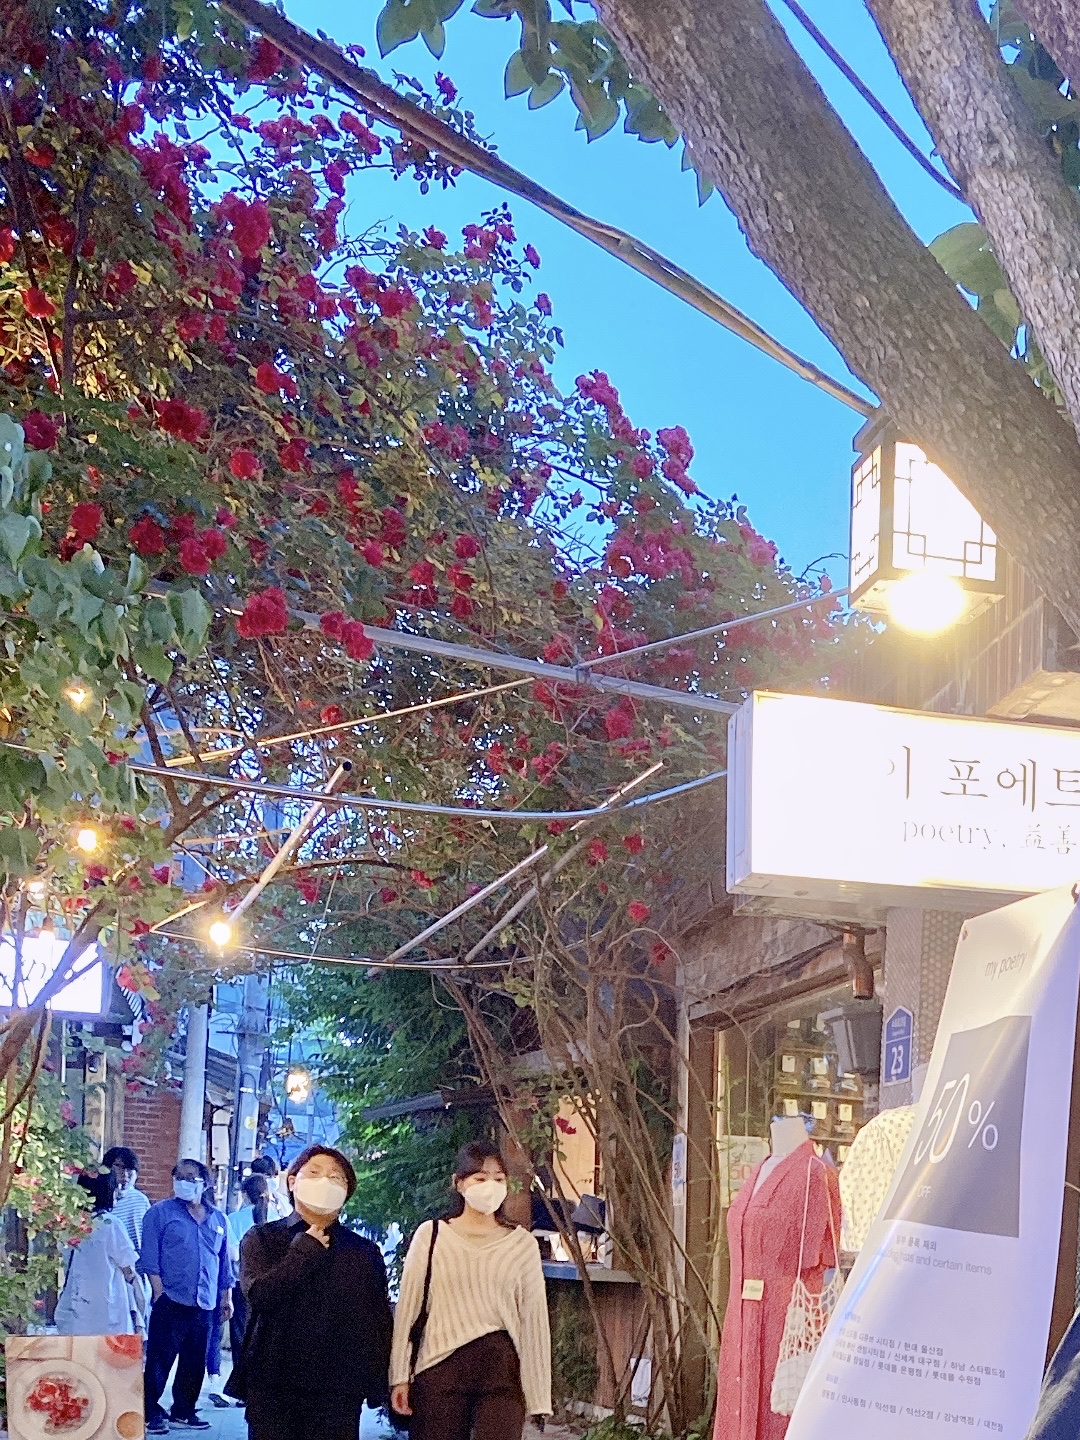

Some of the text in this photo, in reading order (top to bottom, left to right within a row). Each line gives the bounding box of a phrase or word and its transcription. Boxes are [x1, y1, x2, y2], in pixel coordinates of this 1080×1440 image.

[984, 951, 1028, 981] my poetry
[890, 1044, 904, 1076] 23
[913, 1072, 999, 1166] 50%
[922, 1239, 937, 1251] 제외
[915, 1255, 931, 1266] and
[932, 1257, 963, 1271] certain
[965, 1260, 992, 1275] items
[894, 1352, 915, 1364] 신세계
[918, 1356, 940, 1368] 대구점
[950, 1361, 966, 1372] 하남
[969, 1364, 1006, 1379] 스타필드점
[958, 1374, 981, 1386] 수원점
[841, 1394, 867, 1408] 인사동점
[905, 1407, 934, 1420] 익선2점
[944, 1413, 974, 1426] 강남역점
